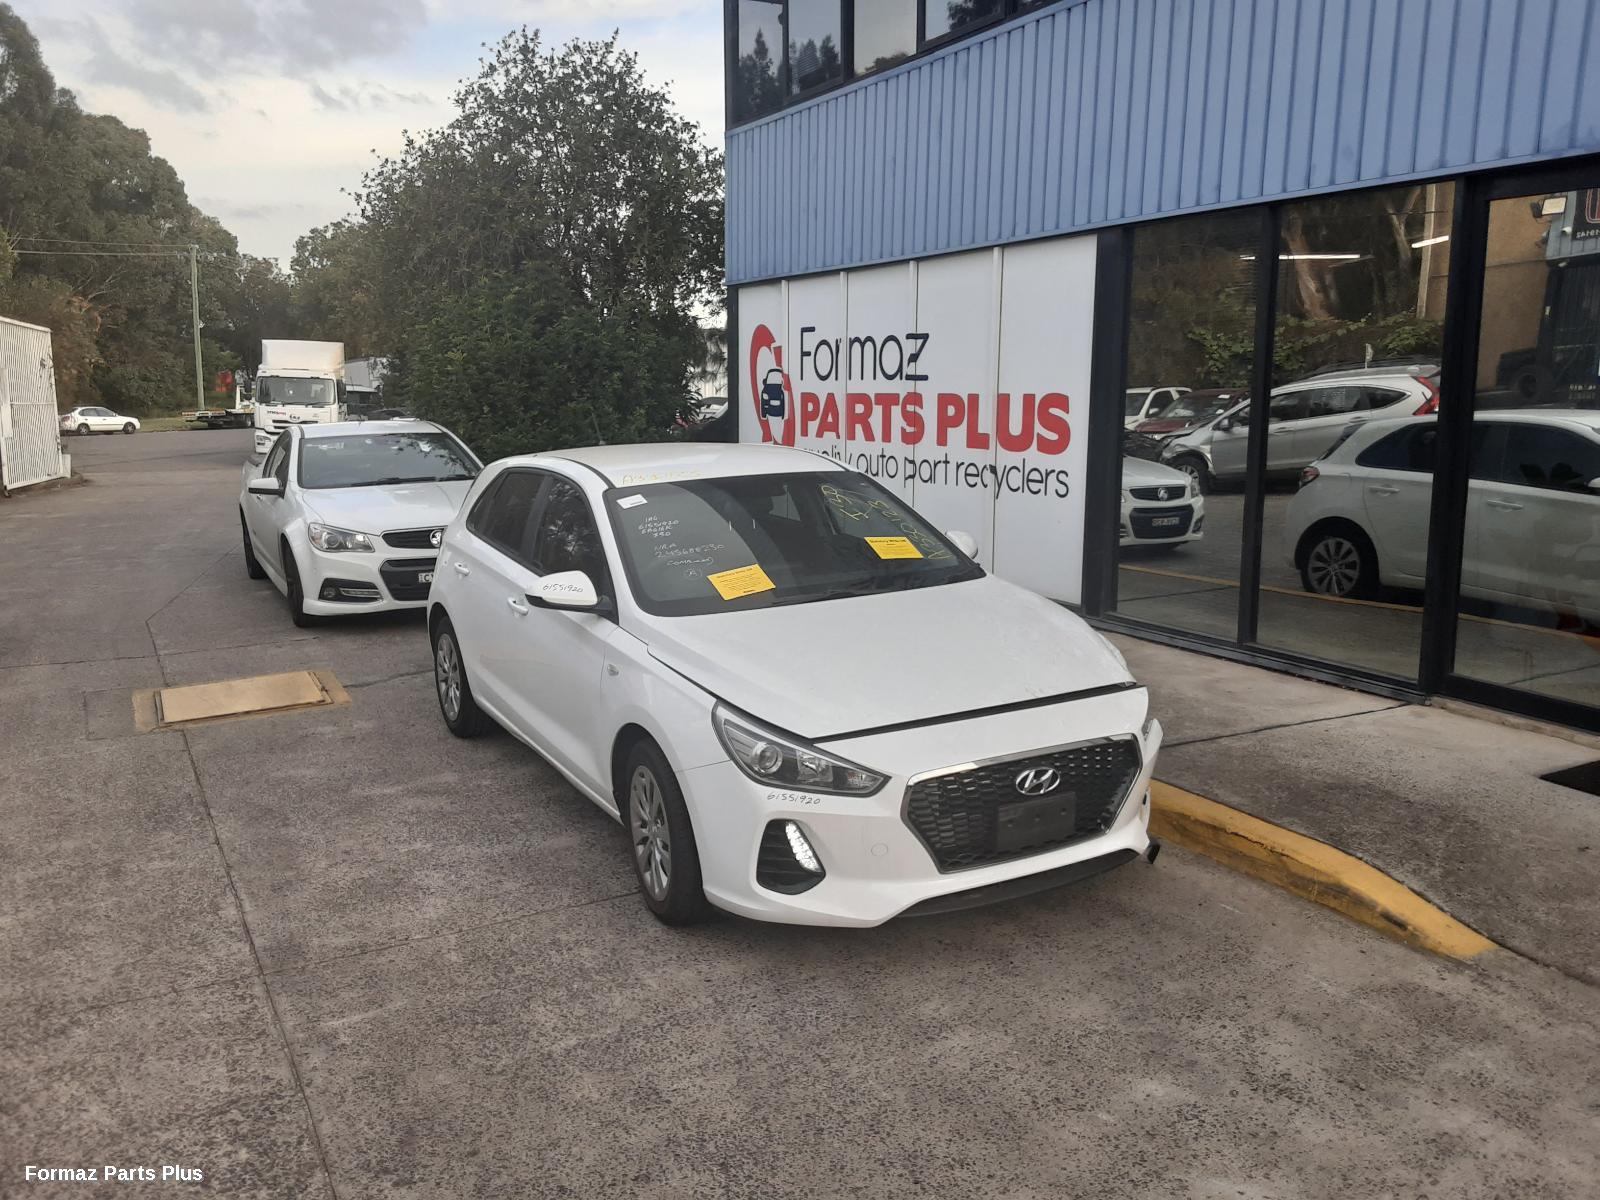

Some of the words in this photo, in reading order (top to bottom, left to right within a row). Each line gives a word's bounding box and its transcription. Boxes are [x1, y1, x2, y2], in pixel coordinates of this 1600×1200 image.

[800, 326, 929, 382] Formaz
[800, 392, 925, 445] PARTS
[936, 392, 1071, 455] PLUS
[856, 447, 898, 479] auto
[904, 451, 949, 489] part
[955, 457, 1070, 500] recyclers
[542, 584, 584, 592] 61551920
[766, 792, 821, 804] 61551920
